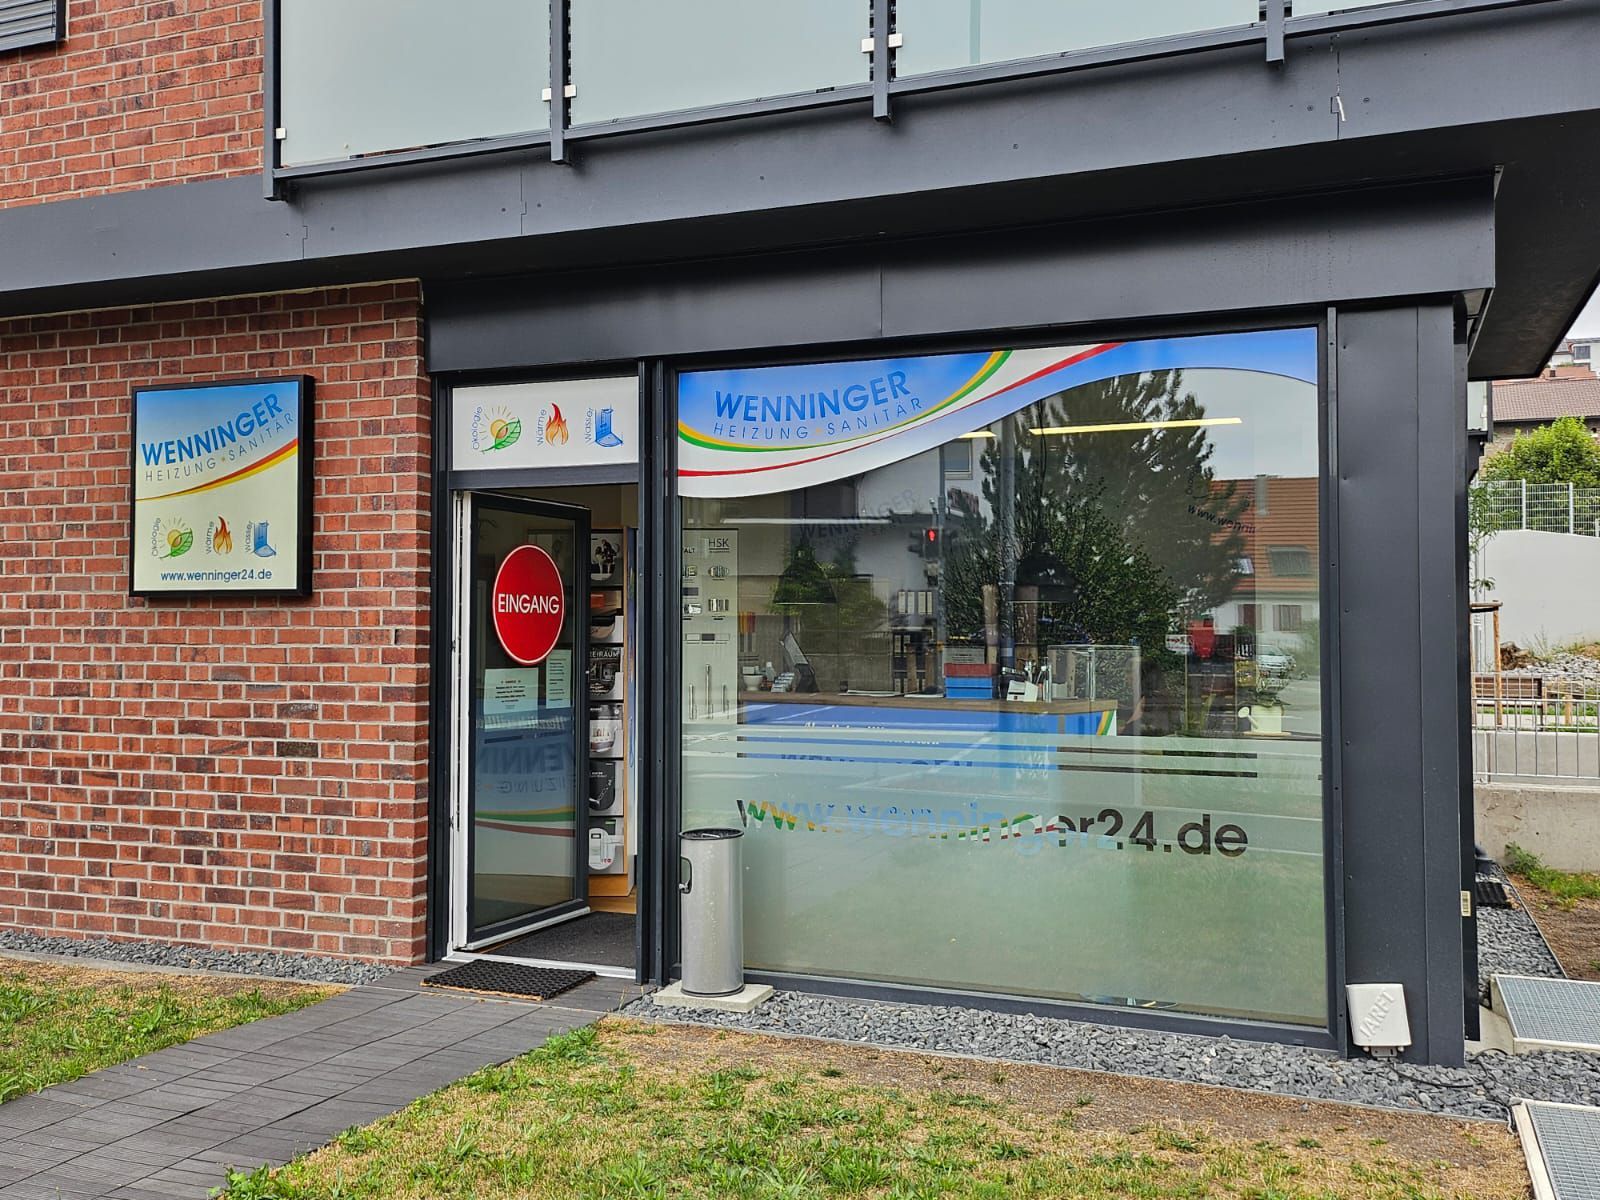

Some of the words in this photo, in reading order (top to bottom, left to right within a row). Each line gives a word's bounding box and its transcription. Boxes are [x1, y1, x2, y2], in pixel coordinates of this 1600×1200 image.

[715, 370, 911, 423] WENNINGER
[141, 393, 283, 467] WENNINGER
[537, 409, 547, 447] Wärme
[584, 407, 593, 442] Wasser
[714, 423, 809, 440] HEIZUNG
[827, 397, 923, 436] SANITÄR
[145, 457, 217, 482] HEIZUNG
[228, 412, 295, 462] SANITÄR
[708, 538, 729, 548] HSK
[160, 569, 273, 583] www.wenninger24.de
[497, 593, 560, 614] EINGANG
[736, 798, 1248, 858] www.wenninger24.de
